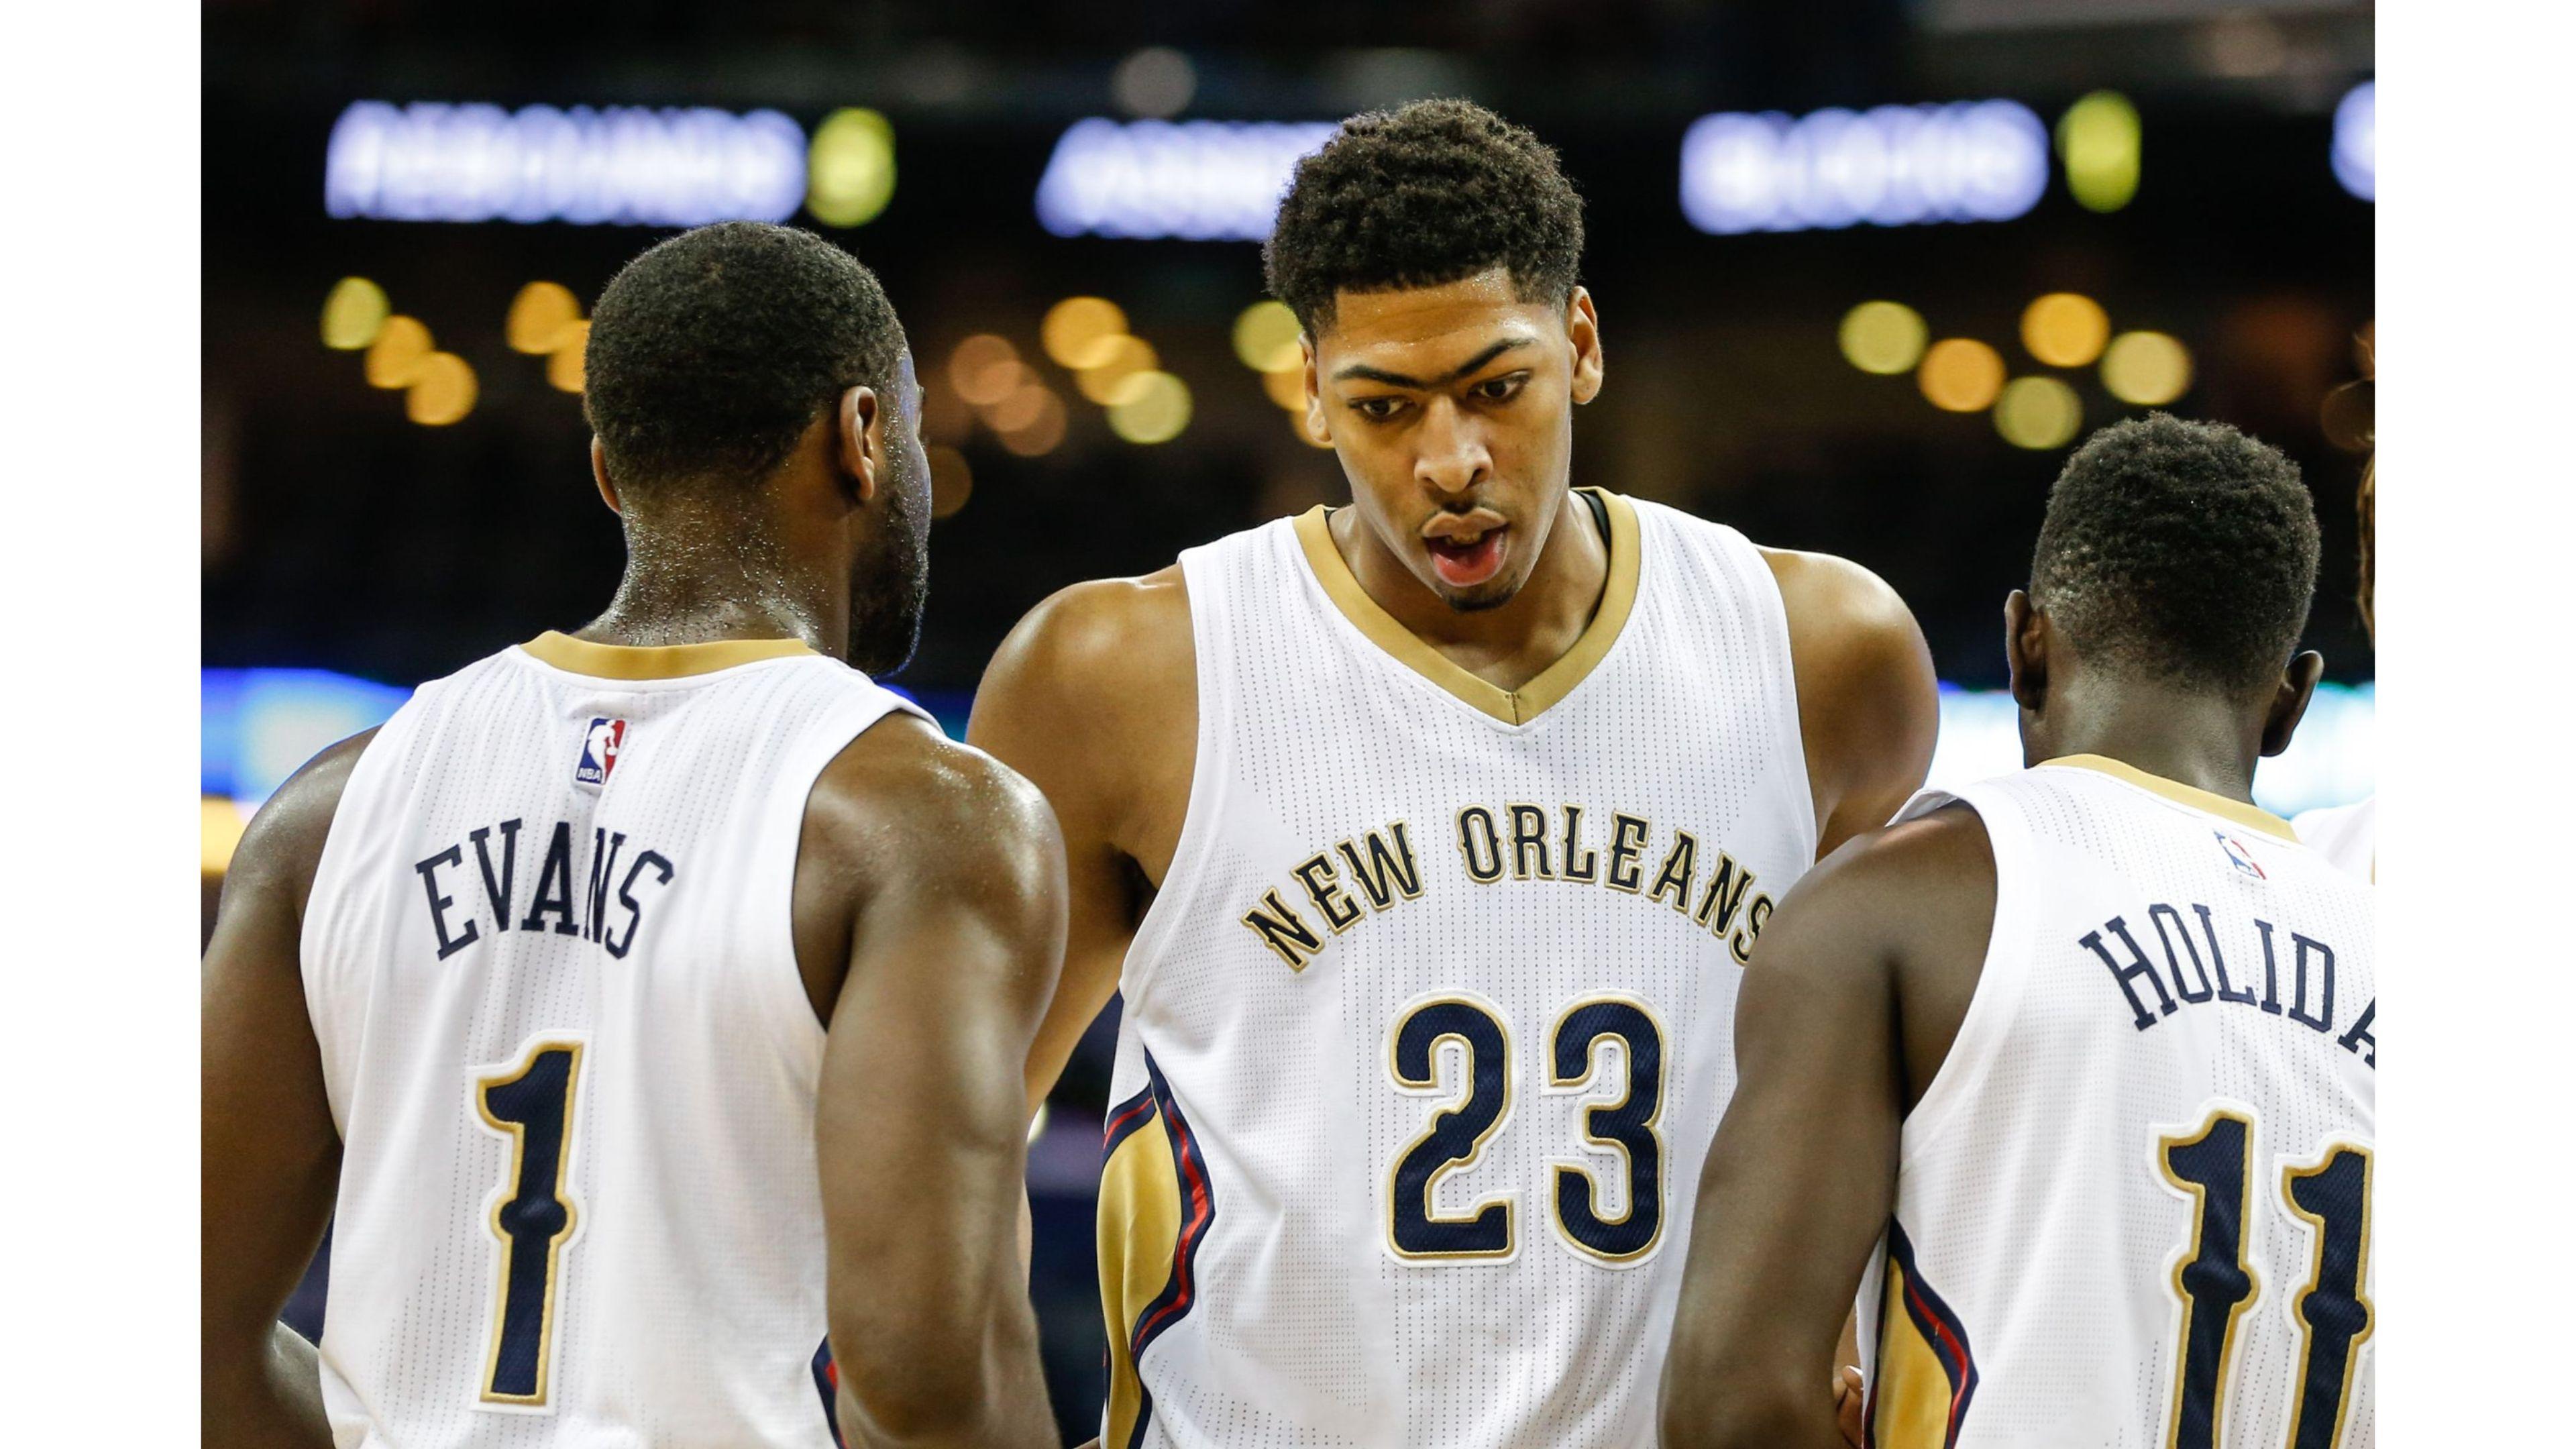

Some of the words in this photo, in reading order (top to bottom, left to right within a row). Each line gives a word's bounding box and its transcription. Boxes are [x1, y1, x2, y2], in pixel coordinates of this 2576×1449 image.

[578, 767, 601, 782] NBA
[415, 818, 674, 961] EVANS
[1240, 818, 1425, 973] NEW
[1455, 802, 1774, 967] ORLEANS
[476, 1041, 584, 1406] 1
[1387, 996, 1666, 1263] 23
[2156, 1110, 2375, 1449] 11
